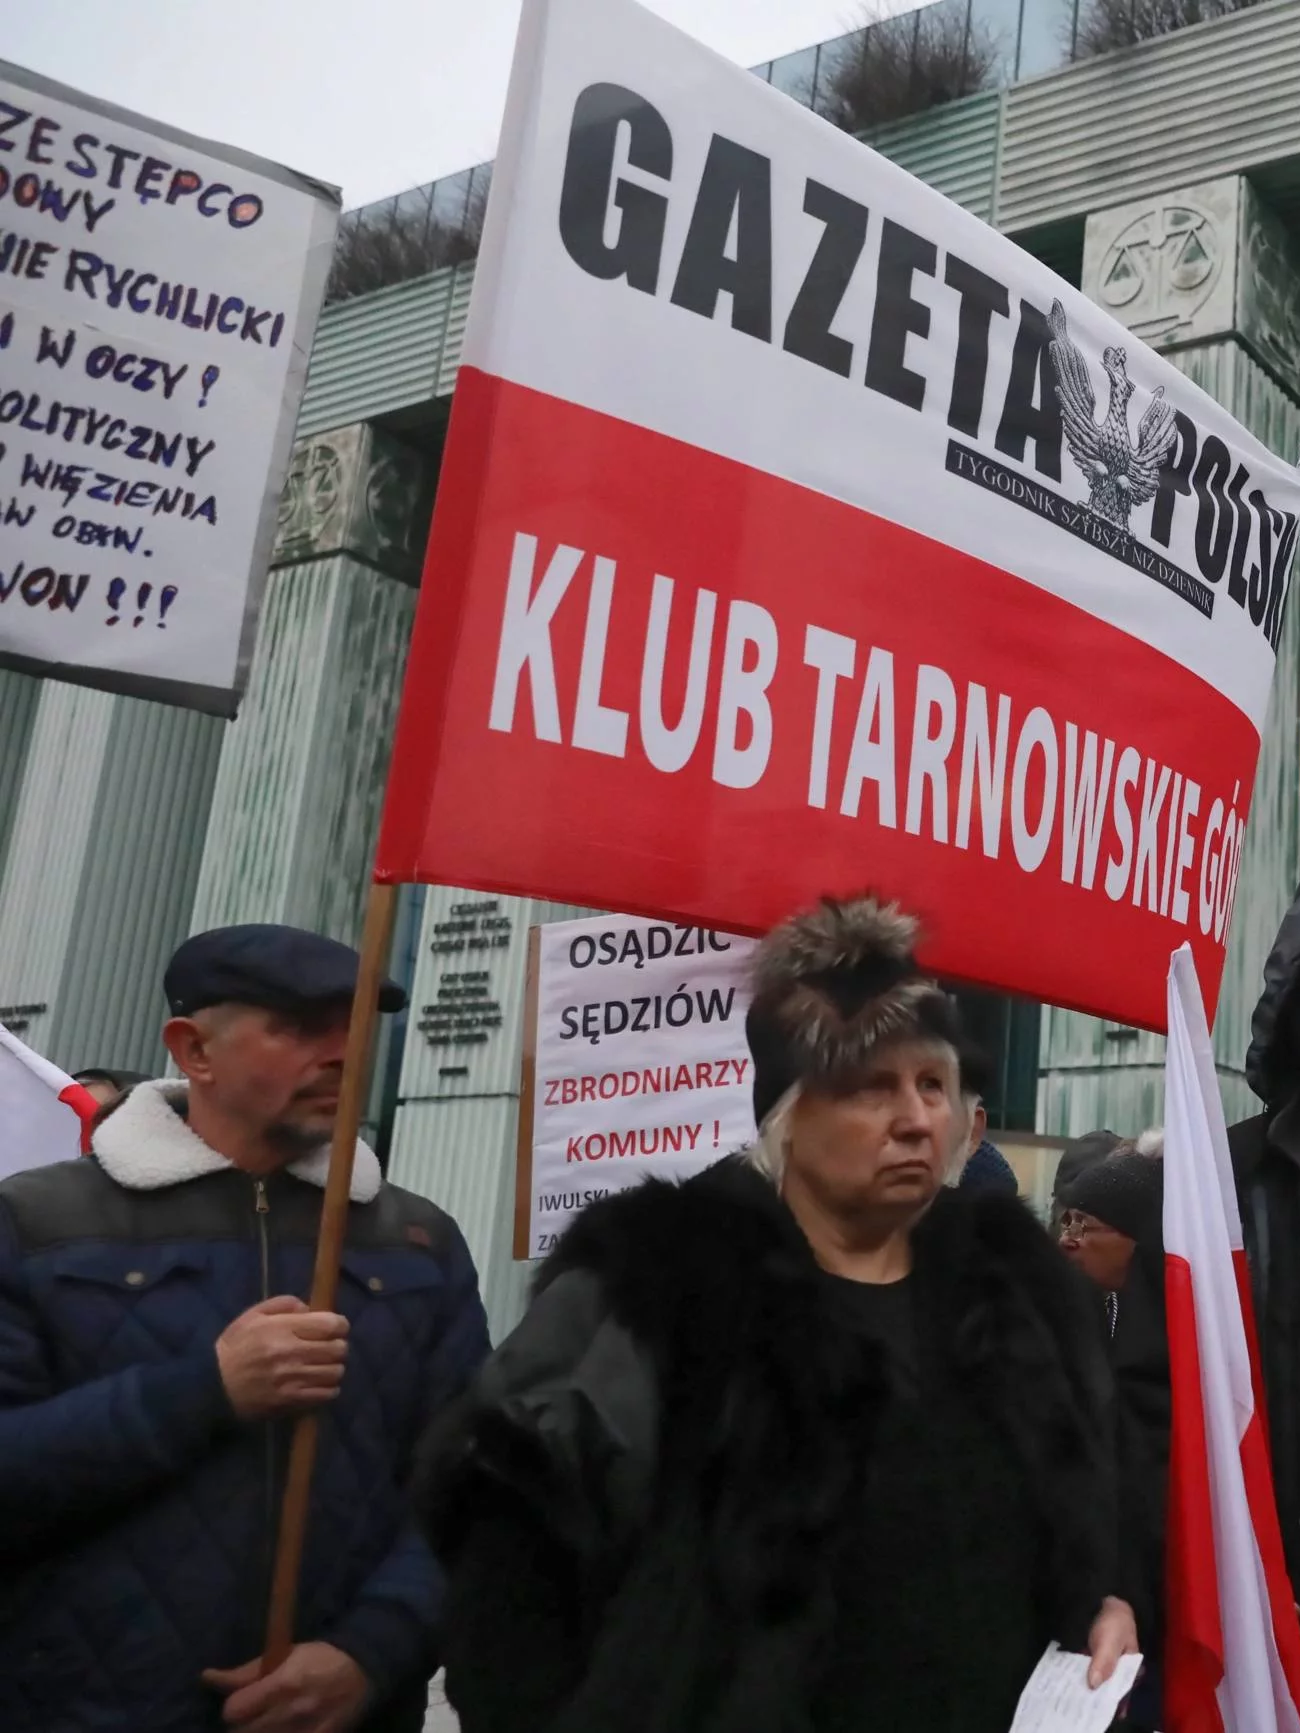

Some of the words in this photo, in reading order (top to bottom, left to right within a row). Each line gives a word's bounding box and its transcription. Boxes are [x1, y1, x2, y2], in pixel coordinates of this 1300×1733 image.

[65, 248, 285, 348] RYCHLICKI
[36, 325, 76, 369] W
[558, 82, 1064, 484] GAZETA
[1150, 410, 1299, 657] POLSK
[956, 449, 1055, 517] TYGODNIK
[1061, 505, 1132, 559] SZYBSZY
[1132, 546, 1155, 573] NIŻ
[1159, 563, 1212, 612] DZIENNIK
[488, 531, 779, 790] KLUB
[803, 624, 1201, 926] TARNOWSKIE
[1199, 779, 1246, 947] GÓR
[560, 983, 736, 1045] SĘDZIÓW
[544, 1058, 749, 1107] ZBRODNIARZY
[566, 1124, 703, 1162] KOMUNY
